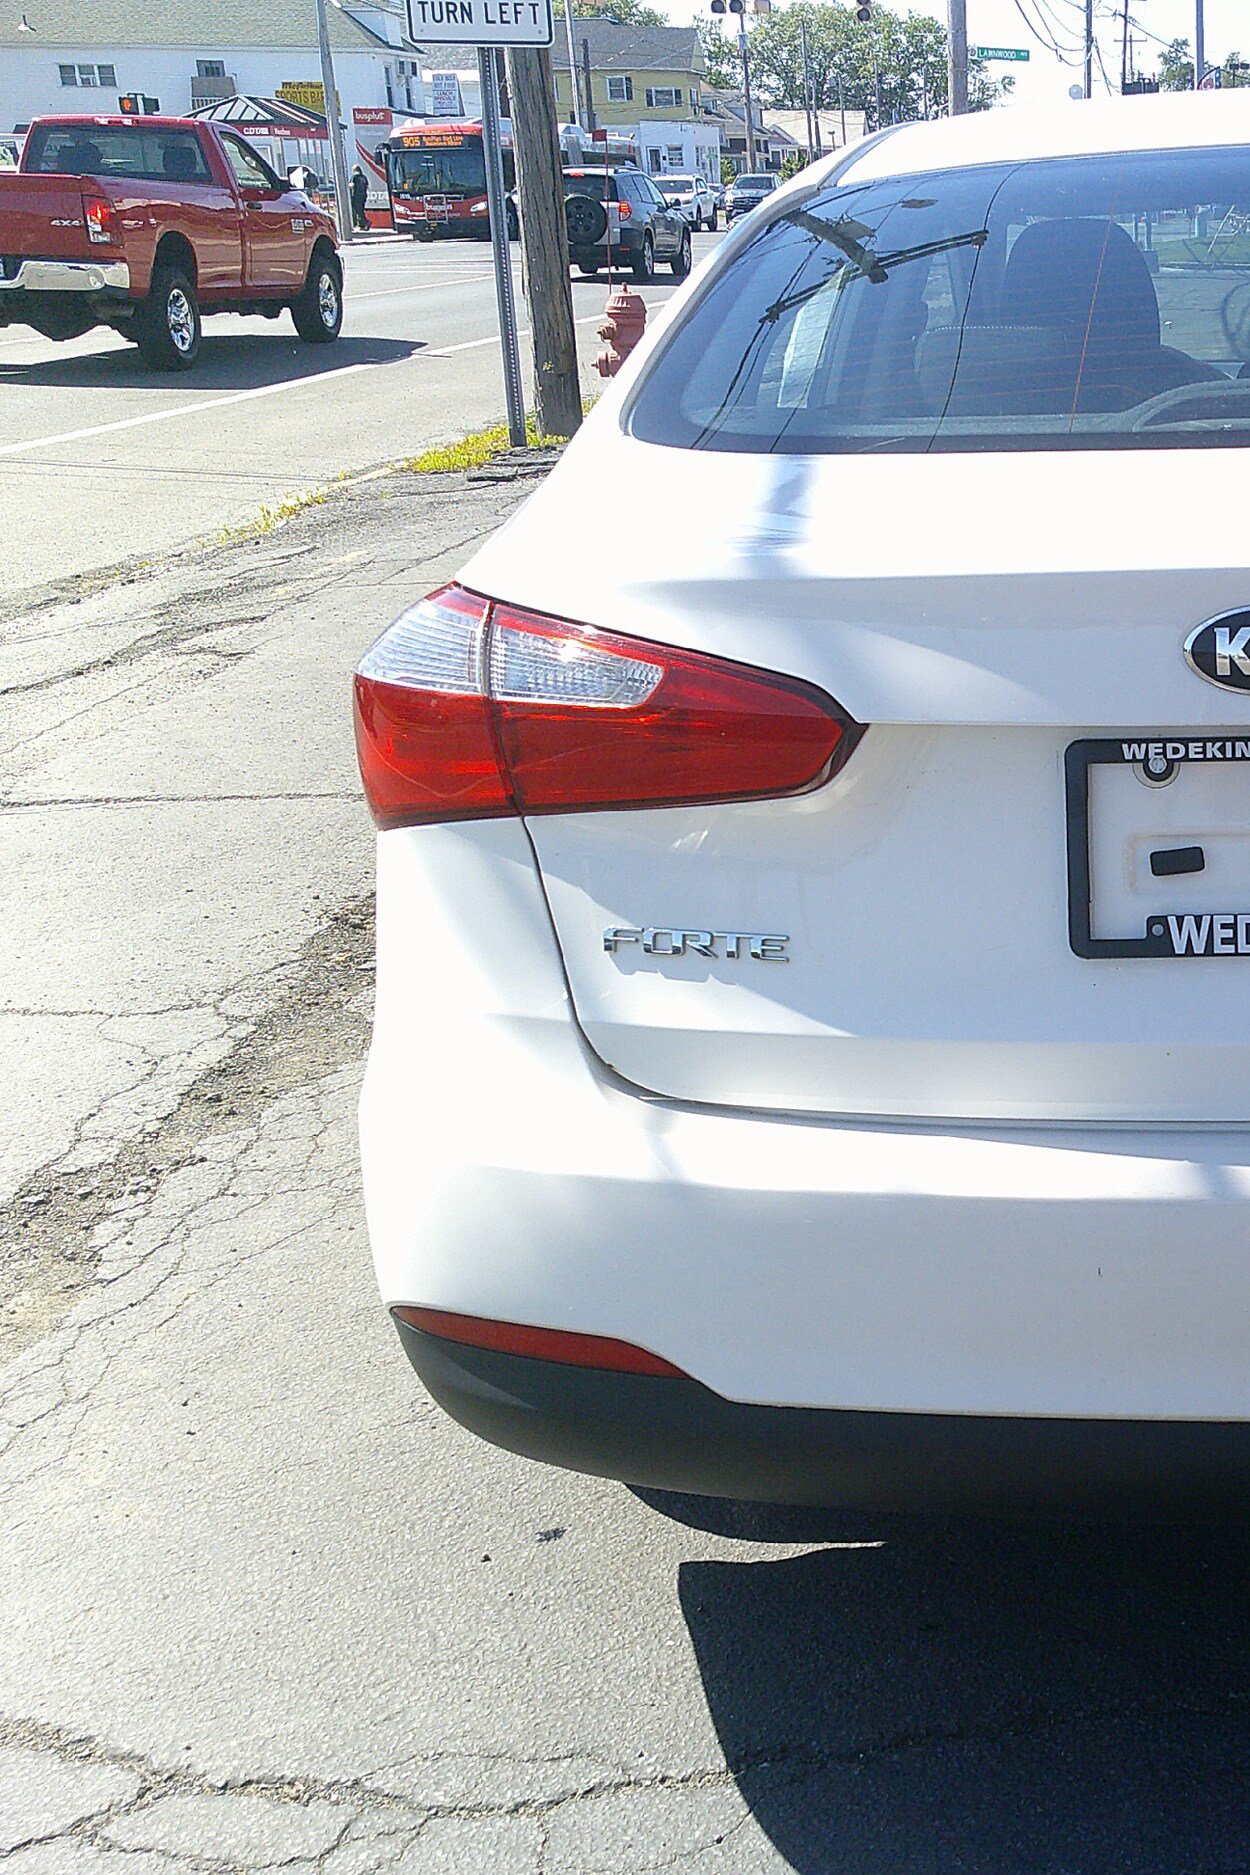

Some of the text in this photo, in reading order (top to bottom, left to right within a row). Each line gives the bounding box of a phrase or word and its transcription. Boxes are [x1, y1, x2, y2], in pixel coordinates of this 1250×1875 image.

[418, 1, 539, 25] TURN LEFT
[979, 49, 1016, 58] LAWNWOOD
[275, 90, 309, 105] SPORTS
[402, 136, 421, 147] 905
[603, 924, 790, 963] FORTE
